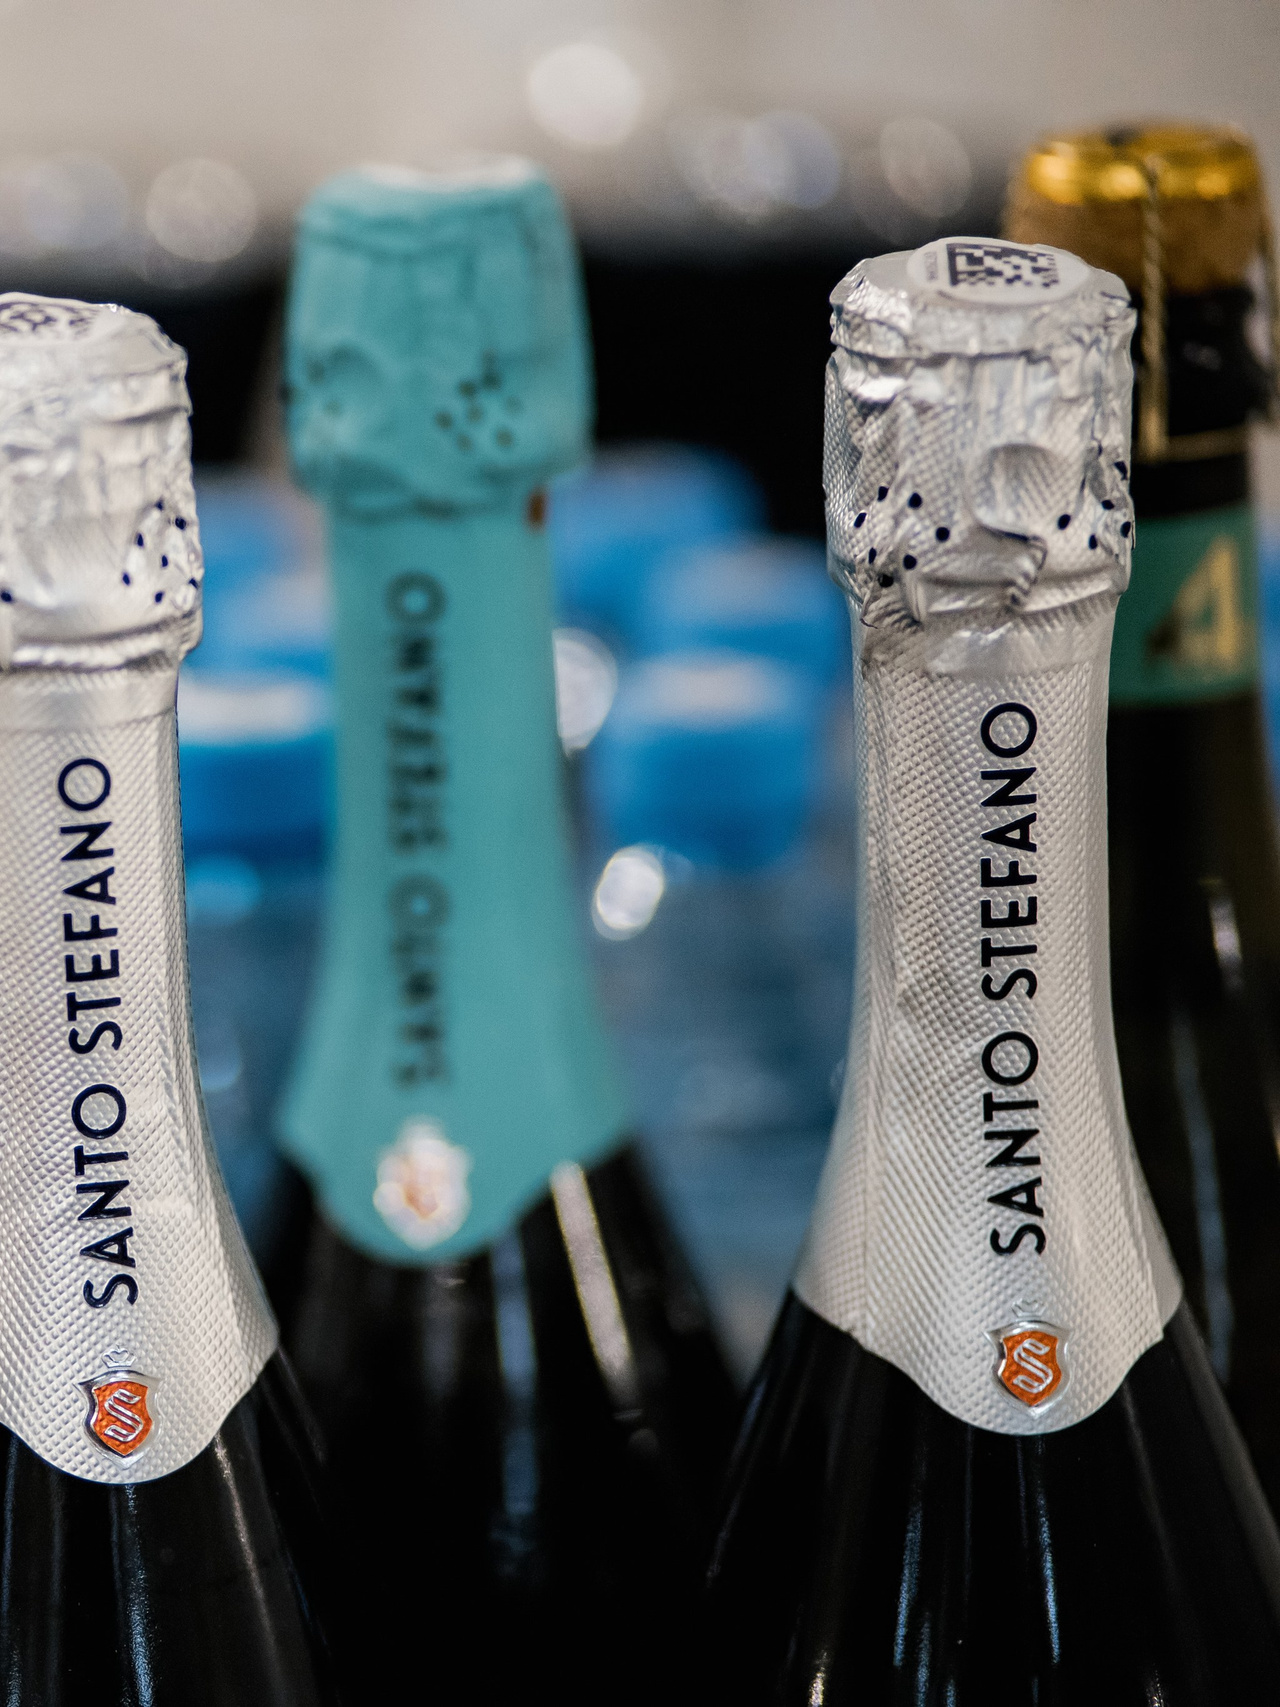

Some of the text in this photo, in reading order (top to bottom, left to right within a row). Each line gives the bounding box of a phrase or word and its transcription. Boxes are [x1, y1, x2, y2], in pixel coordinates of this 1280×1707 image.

[56, 757, 140, 1310] SANTO STEFANO
[979, 701, 1048, 1258] SANTO STEFANO
